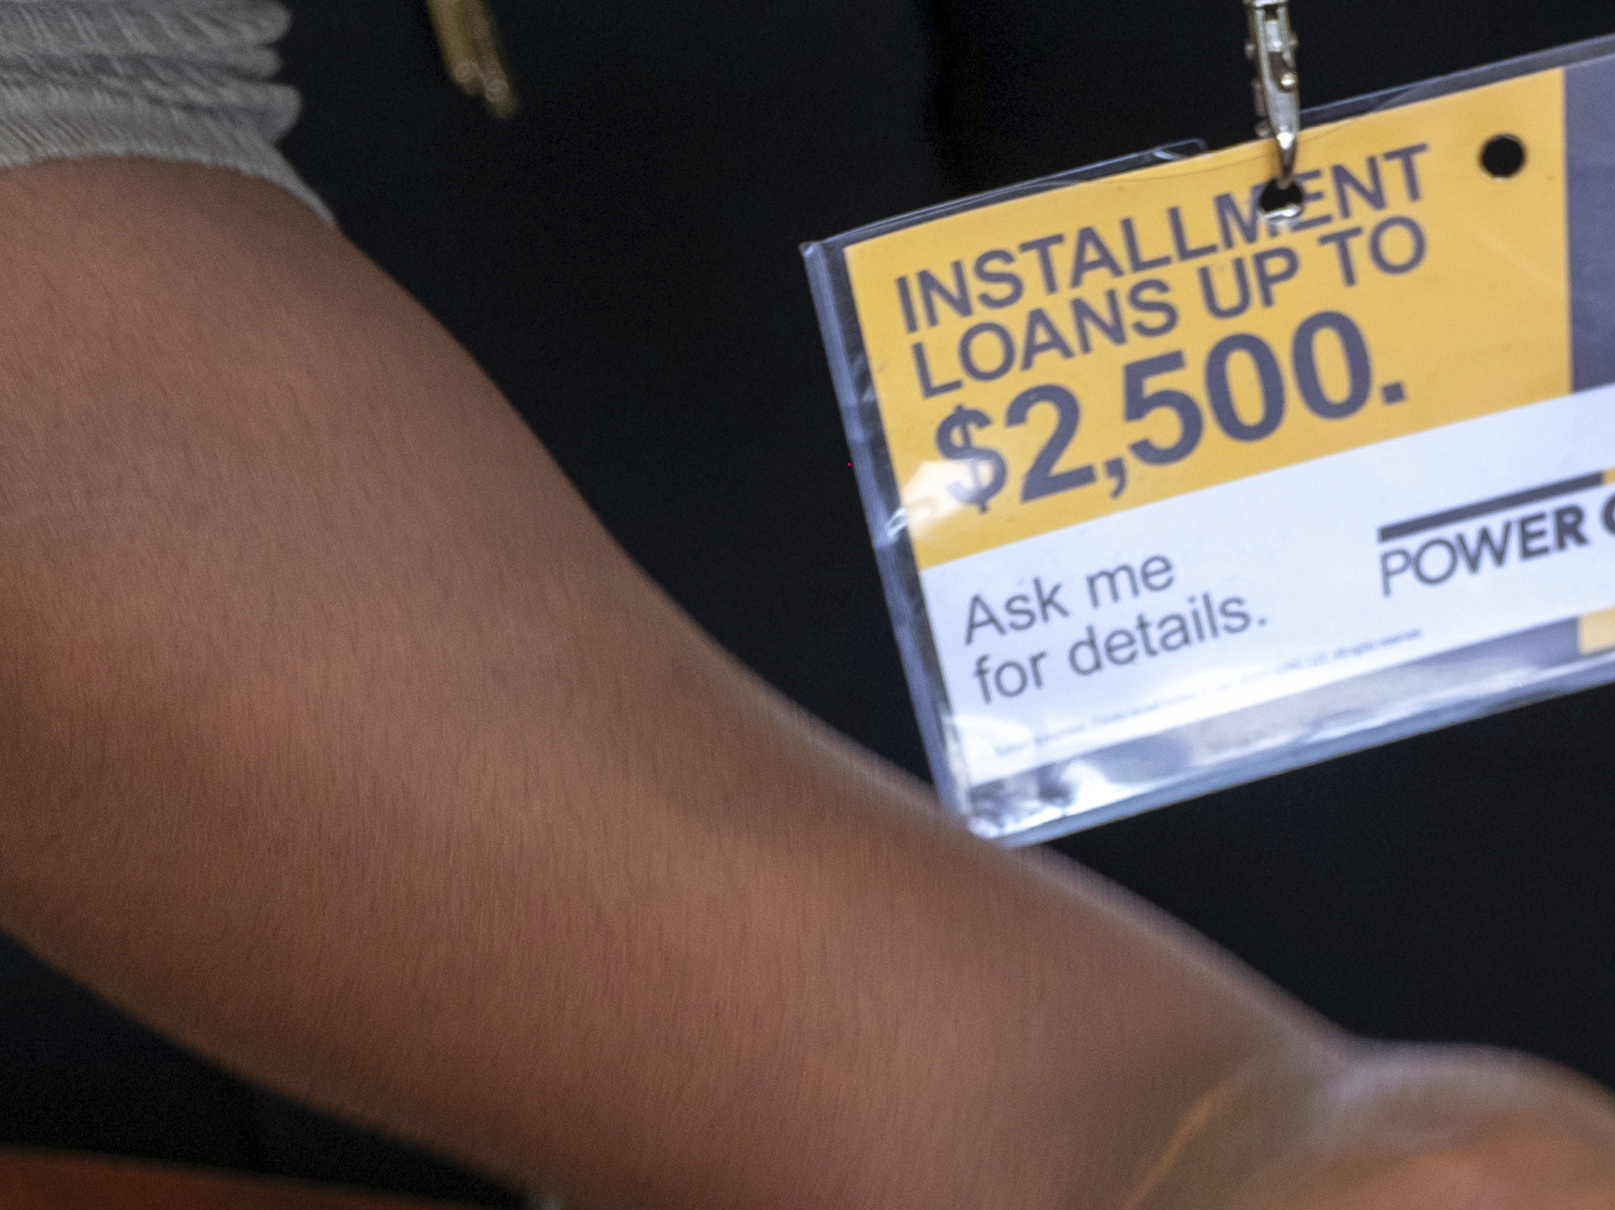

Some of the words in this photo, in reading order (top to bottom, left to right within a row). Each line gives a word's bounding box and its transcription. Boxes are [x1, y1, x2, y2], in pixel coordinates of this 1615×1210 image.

[895, 143, 1428, 334] INSTALLMENT
[911, 279, 1179, 399] LOANS
[1197, 246, 1300, 320] UP
[1317, 215, 1427, 287] TO
[934, 310, 1408, 515] $2,500.
[963, 576, 1071, 646] Ask
[1085, 552, 1177, 609] me
[1379, 503, 1591, 597] POWER
[972, 648, 1049, 704] for
[1067, 592, 1268, 679] details.
